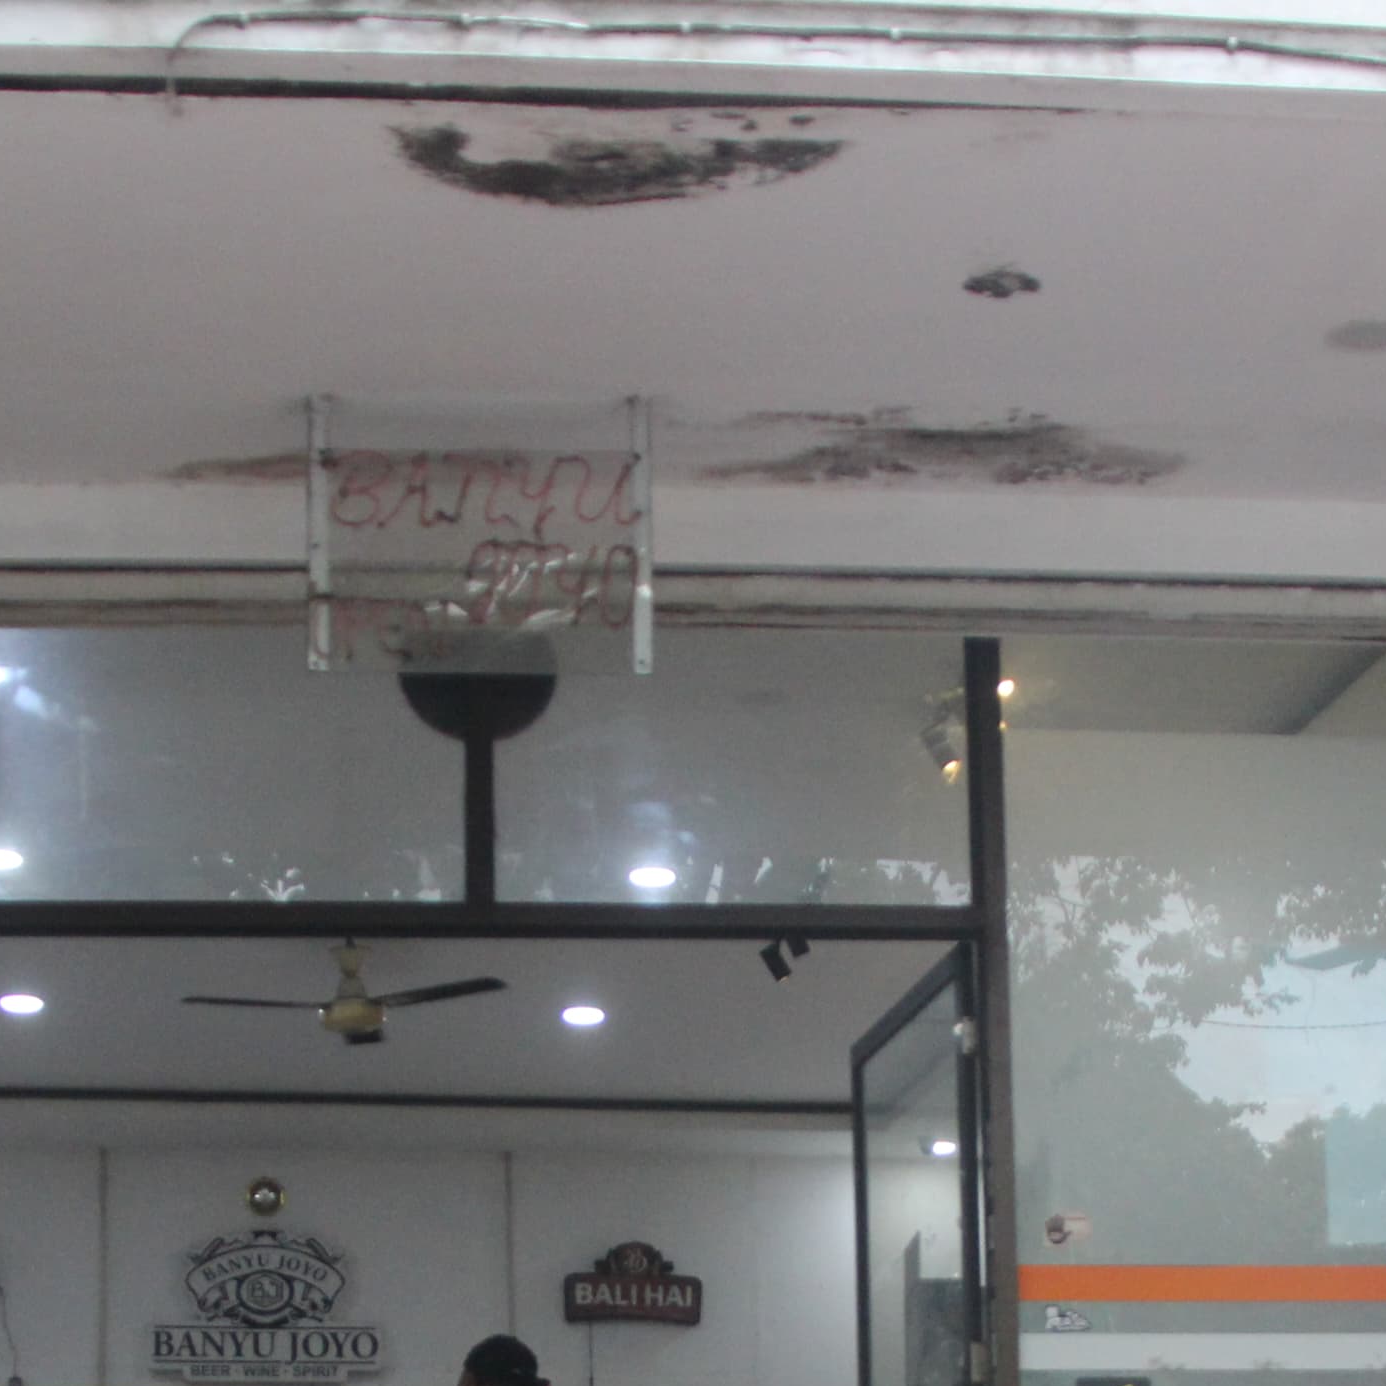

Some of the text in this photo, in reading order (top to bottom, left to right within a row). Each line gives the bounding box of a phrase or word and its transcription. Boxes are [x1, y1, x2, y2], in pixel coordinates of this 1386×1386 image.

[201, 1253, 329, 1284] BANYU JOYO
[574, 1281, 693, 1308] BALI HAI
[152, 1330, 379, 1365] BANYU JOYO
[190, 1365, 339, 1377] BEER WINE SPIRIT
